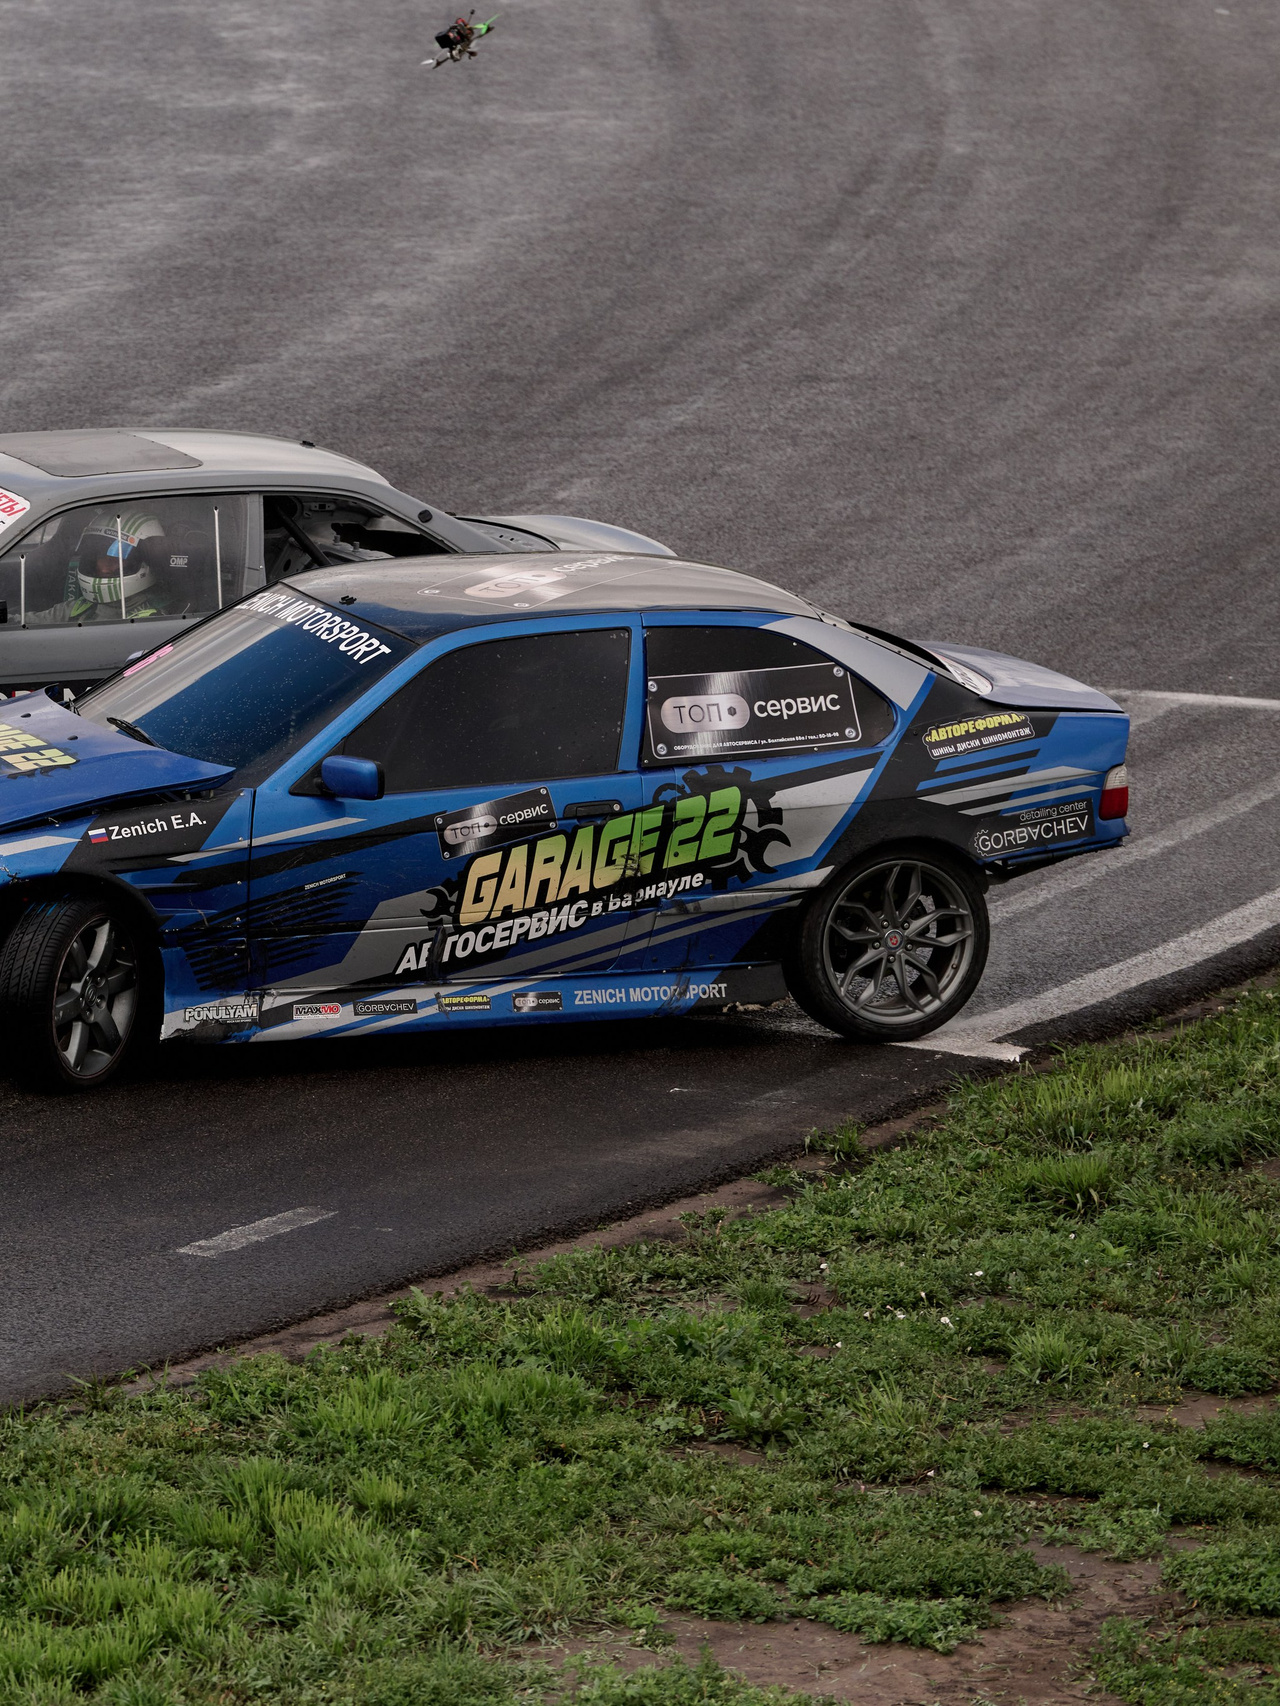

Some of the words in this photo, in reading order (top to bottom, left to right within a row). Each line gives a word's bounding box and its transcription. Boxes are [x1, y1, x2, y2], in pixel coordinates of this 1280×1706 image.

[169, 556, 188, 566] OMP
[274, 600, 392, 665] MOTORSPORT
[673, 702, 723, 724] ТОП
[754, 694, 841, 720] сервис
[925, 712, 1026, 743] «АВТОРЕФОРМА»
[932, 744, 956, 757] ШИНЫ
[957, 738, 981, 752] ДИСКИ
[982, 726, 1032, 745] ШИНОМОНТАЖ
[0, 748, 77, 771] 22
[451, 821, 481, 840] ТОП
[500, 803, 549, 825] сервис
[1020, 808, 1058, 821] detailing
[1058, 801, 1087, 816] center
[109, 818, 169, 840] Zenich
[171, 811, 207, 830] E.A.
[459, 804, 666, 927] GARAGE
[663, 786, 742, 868] 22
[591, 901, 604, 917] в
[295, 1002, 340, 1015] MAXMO
[538, 997, 560, 1005] сервис
[574, 989, 626, 1005] ZENICH
[185, 1004, 258, 1021] PONULYAM
